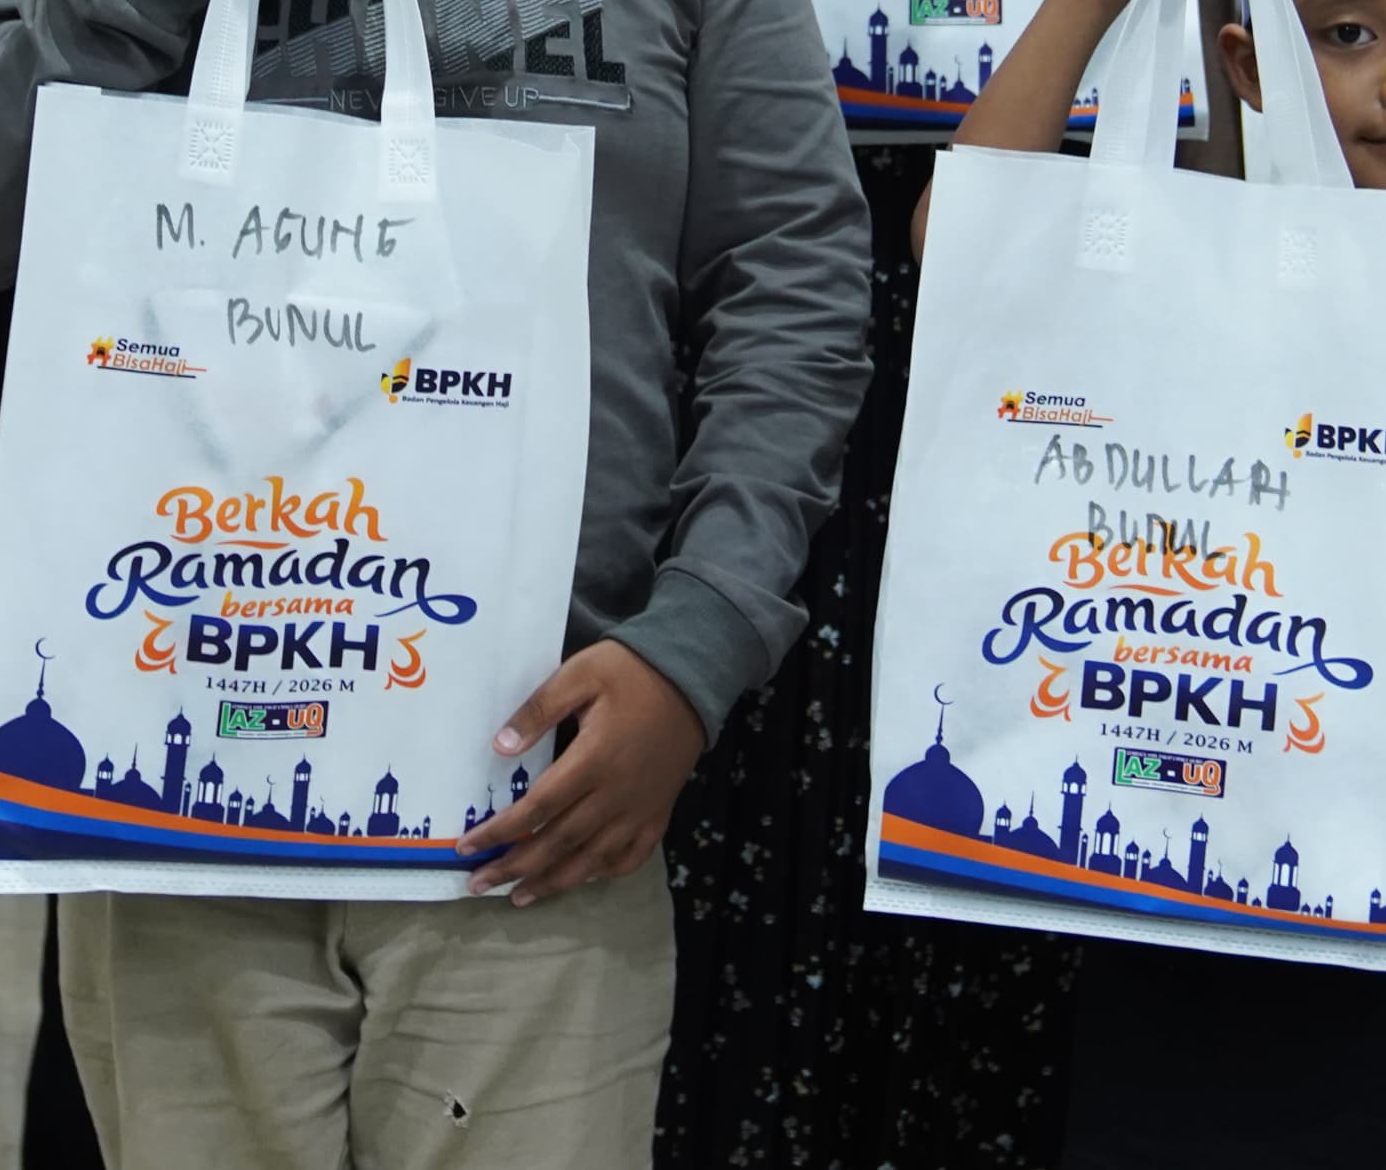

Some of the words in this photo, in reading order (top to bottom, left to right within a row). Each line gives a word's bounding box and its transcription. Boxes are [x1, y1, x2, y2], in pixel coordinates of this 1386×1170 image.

[434, 86, 497, 109] GIVE
[504, 85, 541, 109] UP
[156, 202, 205, 251] M.
[227, 297, 377, 353] BUNUL
[112, 352, 195, 376] BisaHaji
[116, 337, 180, 357] Semua
[415, 368, 512, 398] BPKH
[1025, 391, 1086, 407] Semua
[1022, 406, 1101, 426] BisaHaji
[155, 476, 388, 544] Berkah
[1048, 521, 1284, 598] Berkah
[85, 538, 477, 625] Ramadan
[220, 590, 355, 618] bersama
[186, 613, 380, 672] BPKH
[982, 586, 1374, 690] Ramadan
[1113, 635, 1253, 673] bersama
[205, 676, 266, 694] 1447H
[288, 679, 332, 693] 2026
[339, 679, 355, 693] M
[1080, 659, 1278, 732] BPKH
[1100, 722, 1160, 742] 1447H
[1183, 732, 1230, 752] 2026
[1237, 739, 1253, 754] M
